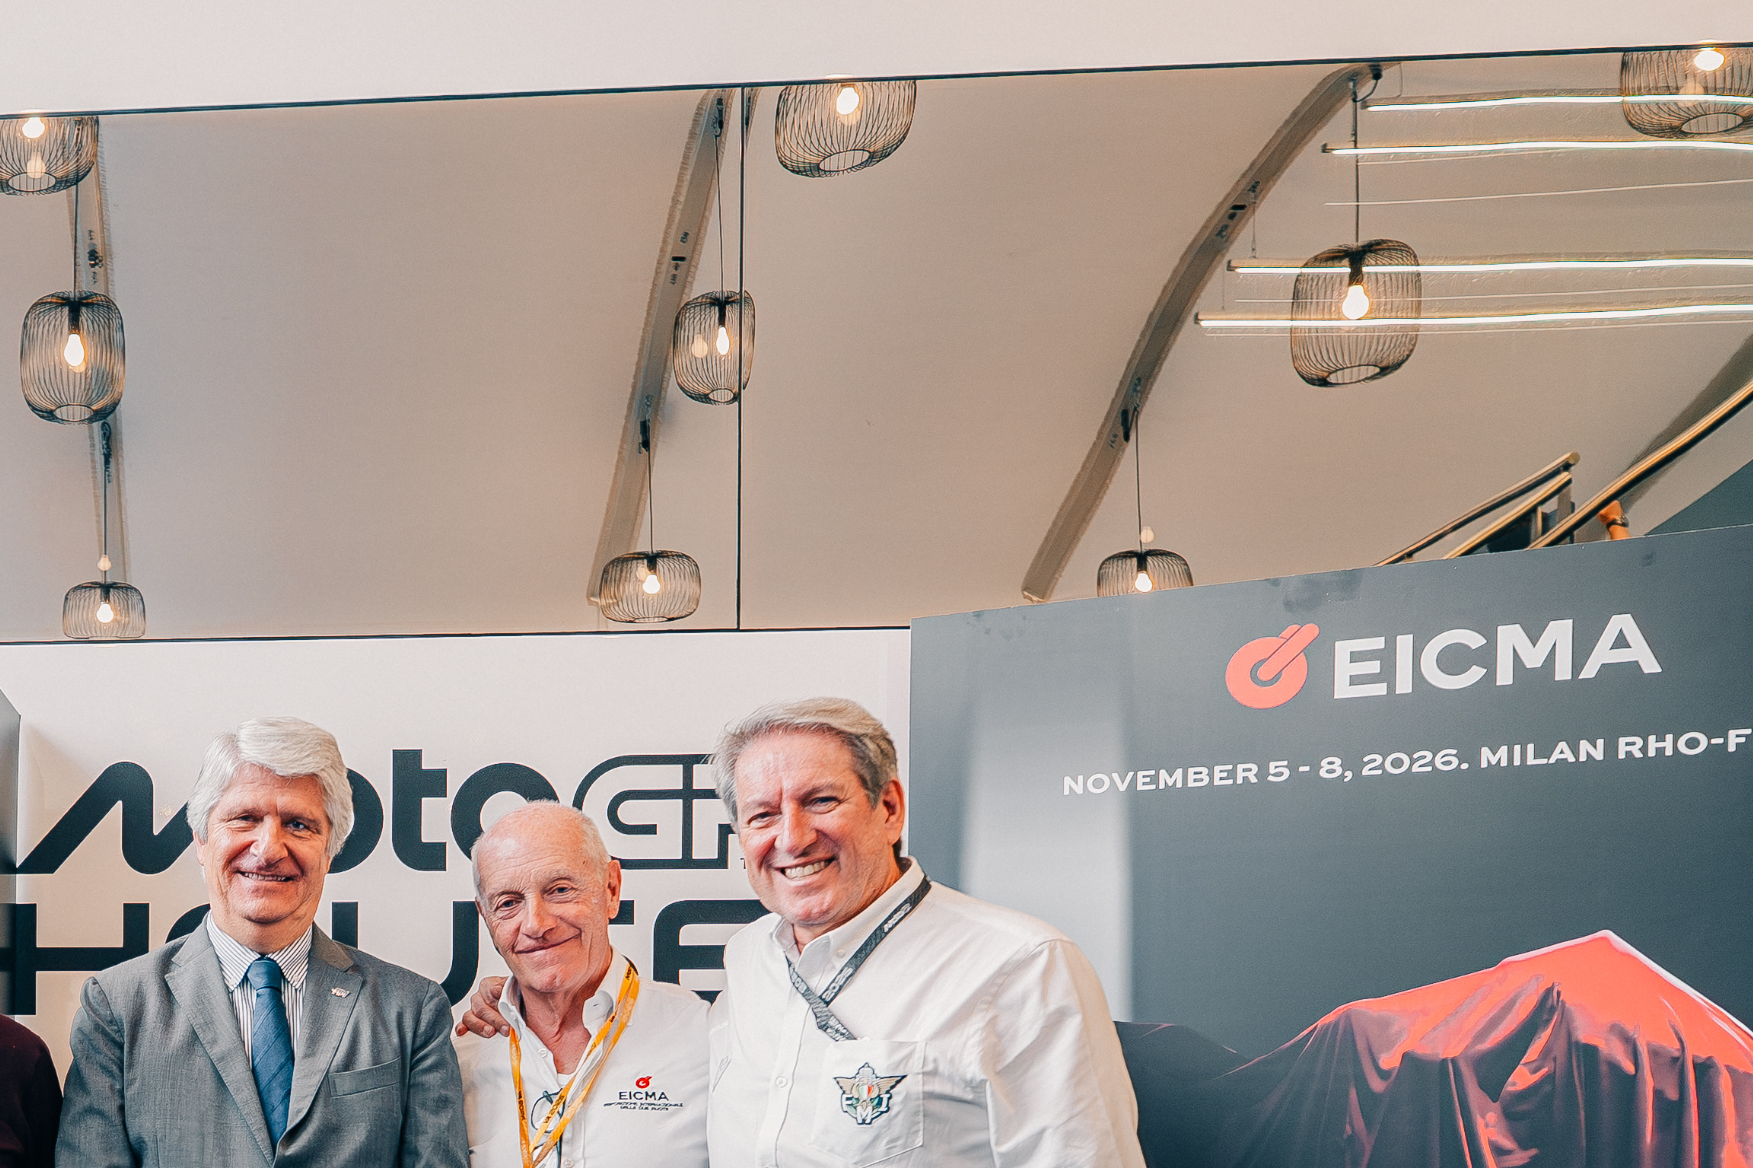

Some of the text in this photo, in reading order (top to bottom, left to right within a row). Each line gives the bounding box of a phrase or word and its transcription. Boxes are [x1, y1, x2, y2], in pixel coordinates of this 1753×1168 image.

[1333, 613, 1663, 700] EICMA
[1063, 763, 1258, 796] NOVEMBER
[1266, 760, 1291, 782] 5
[1361, 748, 1470, 776] 2026.
[1480, 738, 1605, 768] MILAN
[618, 1091, 669, 1101] EICMA
